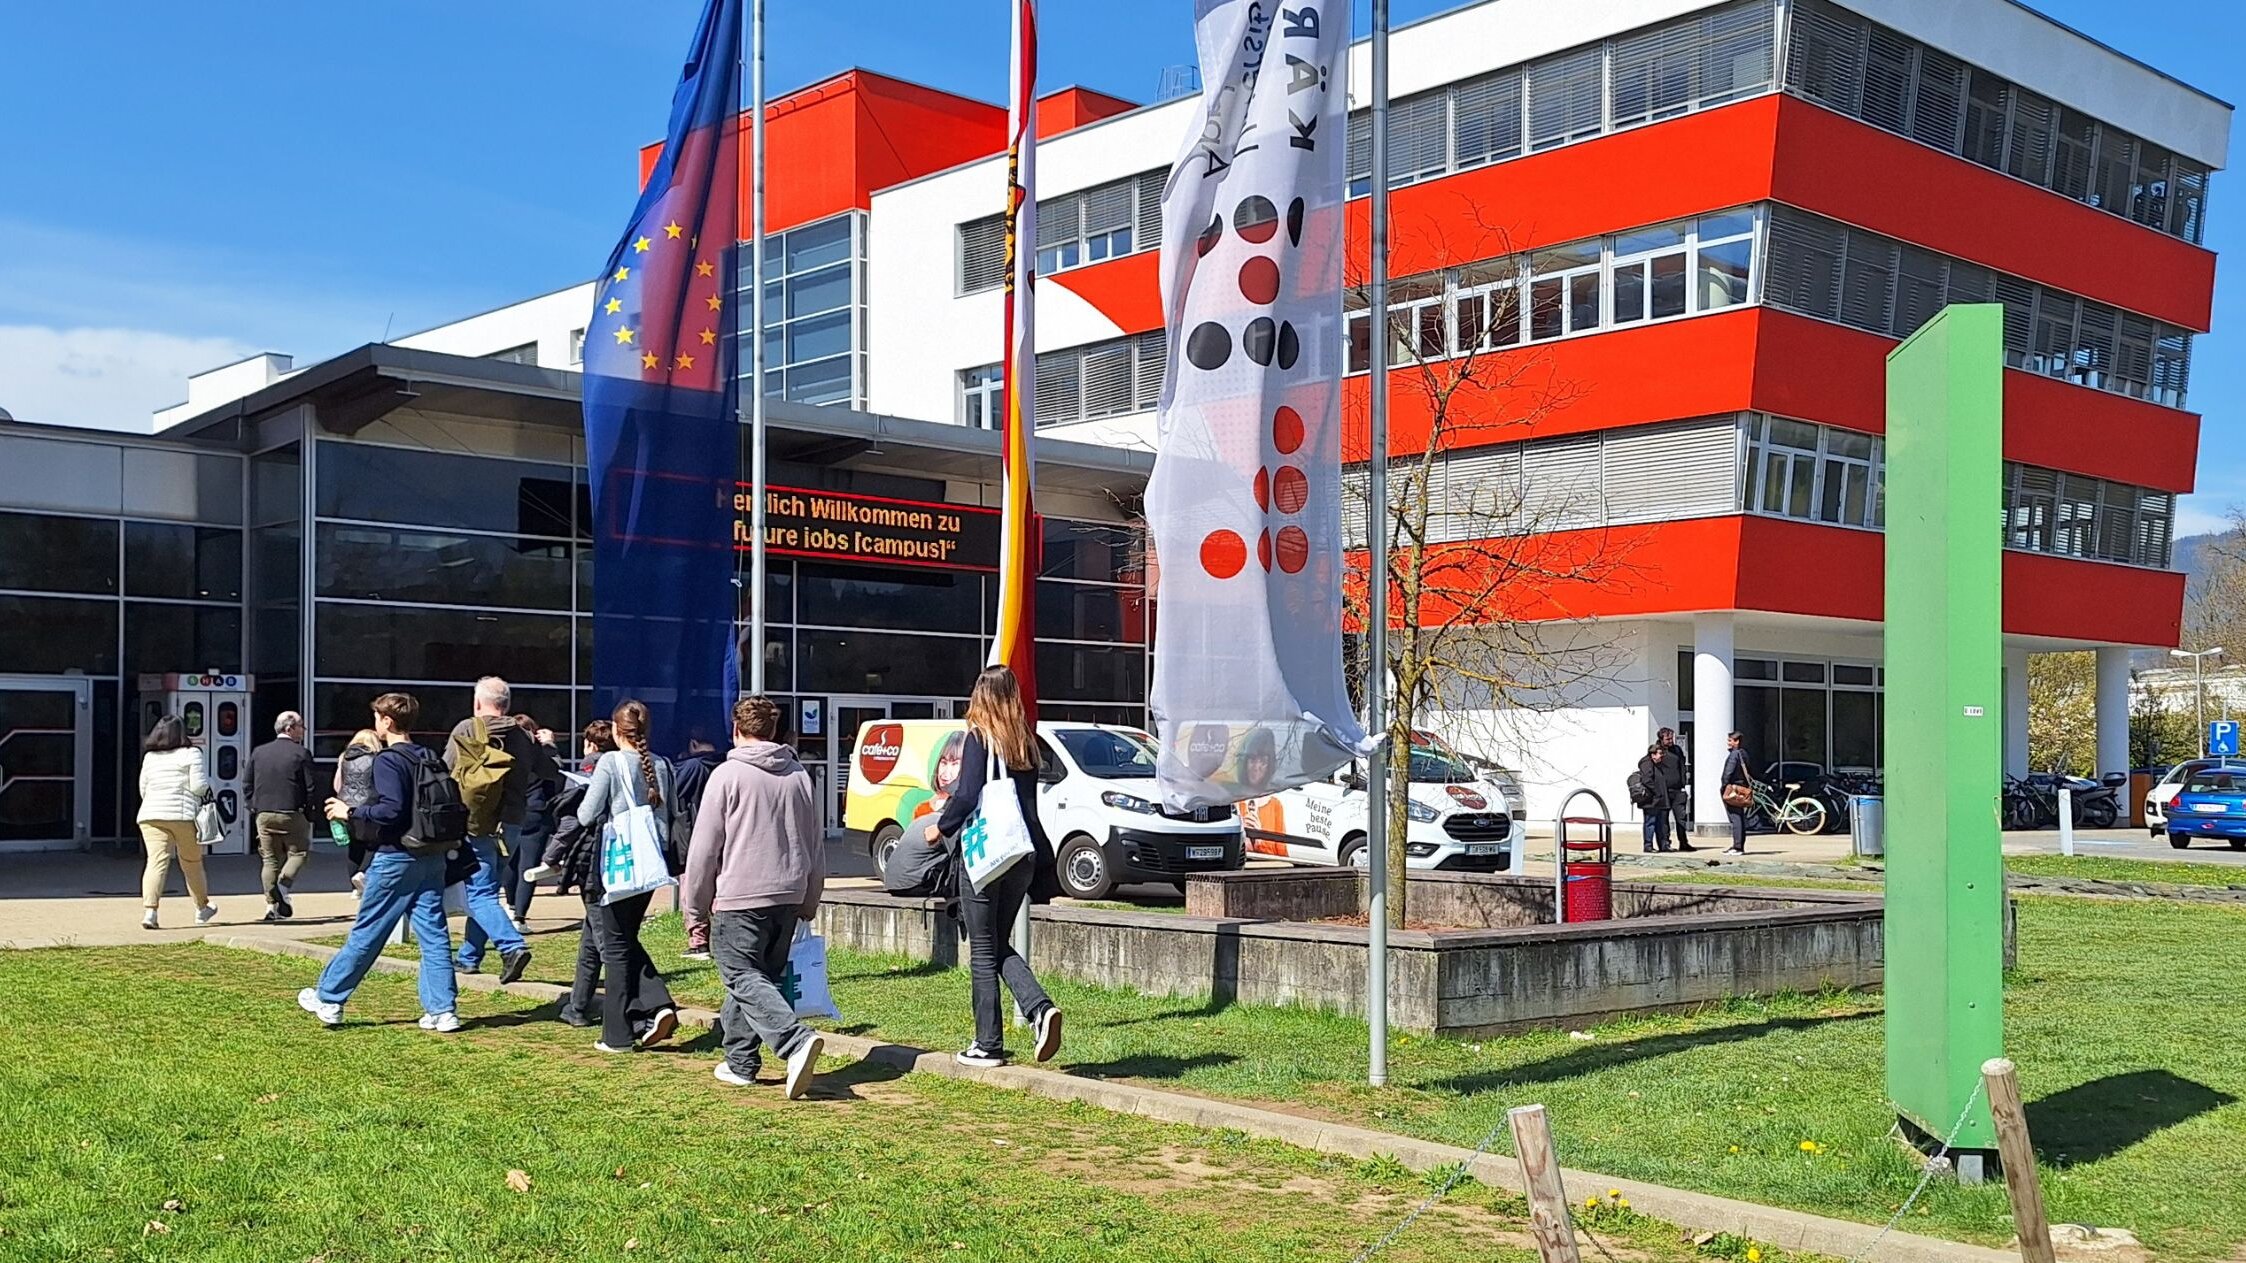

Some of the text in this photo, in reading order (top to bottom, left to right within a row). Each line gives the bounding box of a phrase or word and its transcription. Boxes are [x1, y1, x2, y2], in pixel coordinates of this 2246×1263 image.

[716, 488, 961, 532] erlich Willkommen zu
[733, 520, 798, 546] fuure
[2216, 723, 2231, 740] P
[1310, 812, 1332, 829] beste
